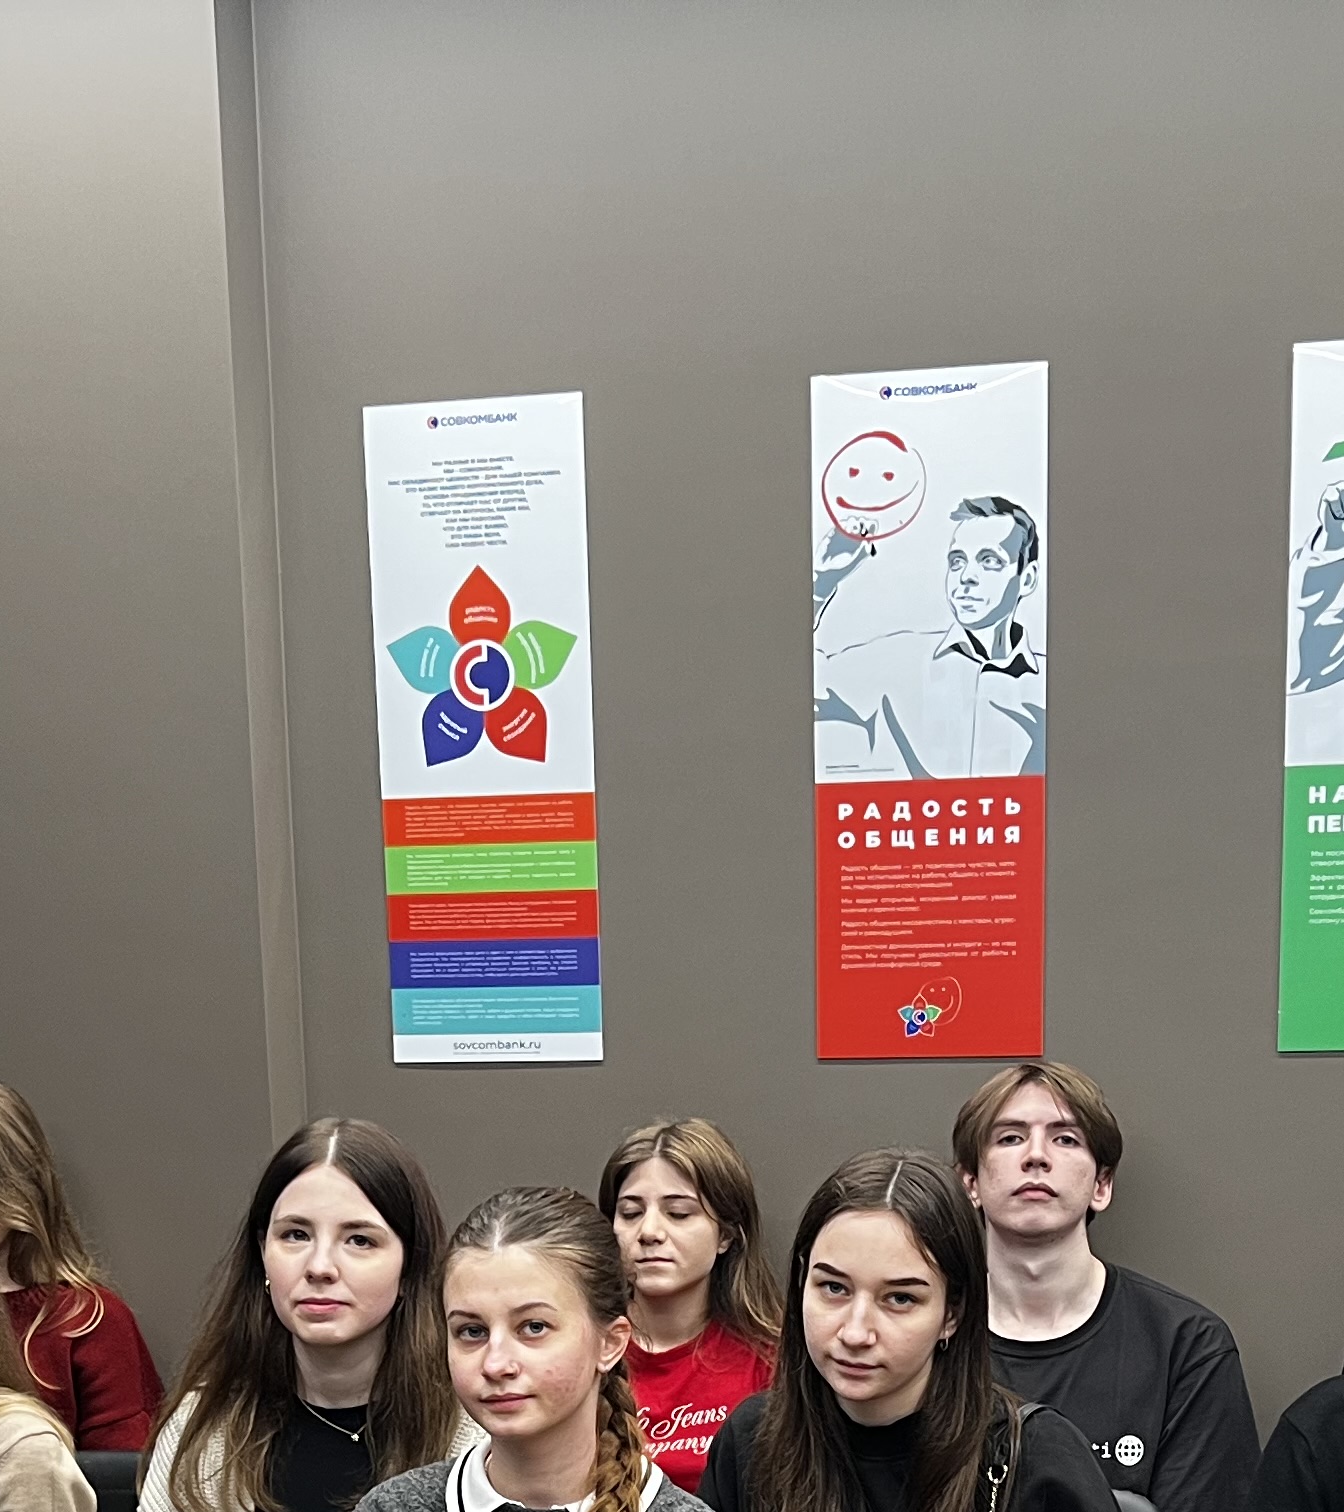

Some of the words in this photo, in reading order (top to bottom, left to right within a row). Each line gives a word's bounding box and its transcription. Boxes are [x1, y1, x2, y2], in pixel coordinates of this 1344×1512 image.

[894, 382, 978, 396] СОВКОМБАНК
[440, 412, 518, 427] СОВКОМБАНК
[837, 797, 1022, 822] РАДОСТЬ
[837, 825, 1022, 850] ОБЩЕНИЯ
[453, 1040, 542, 1050] sovcombank.ru
[650, 1402, 728, 1440] Jeans
